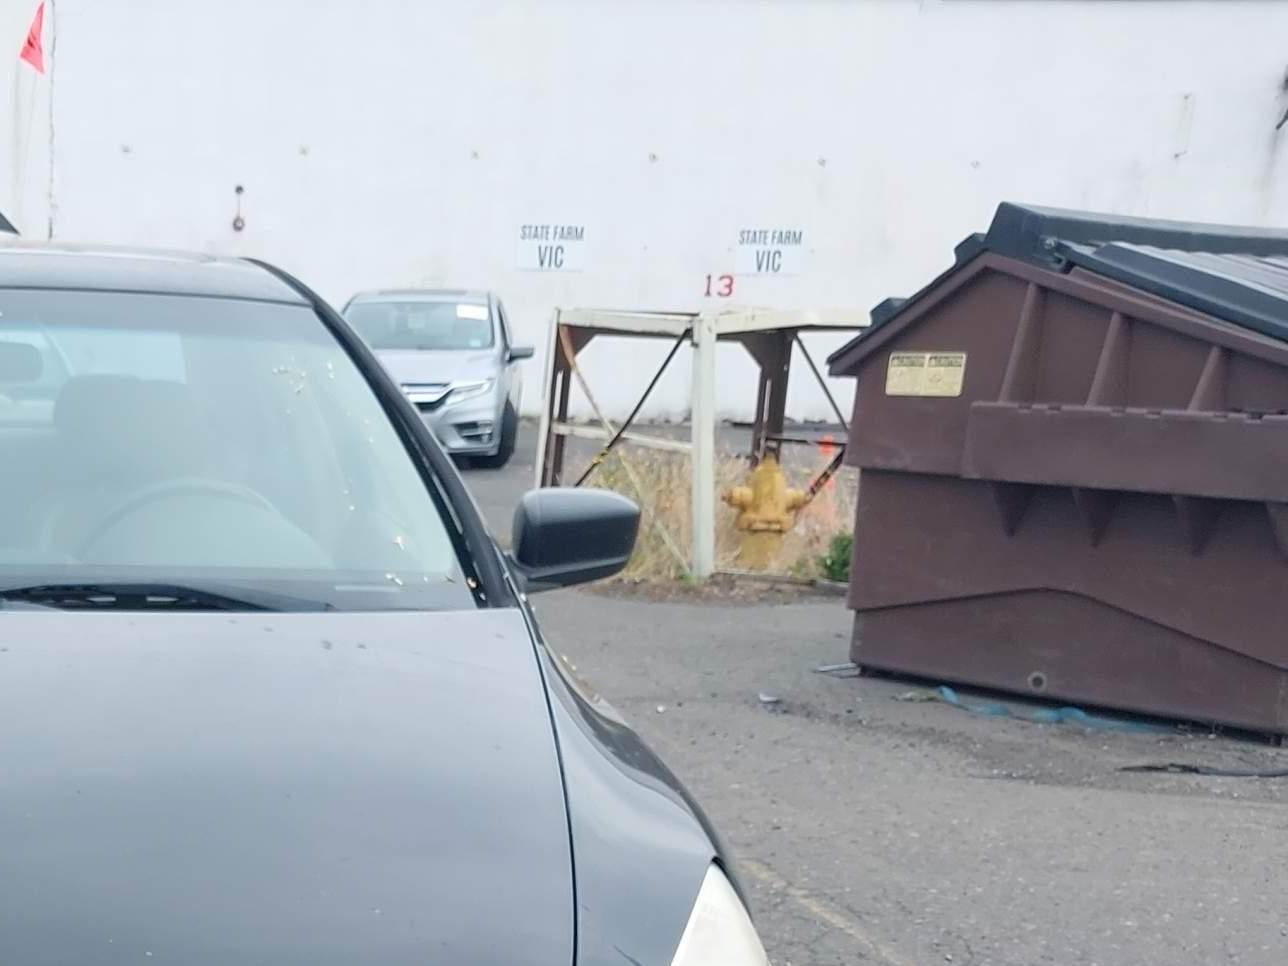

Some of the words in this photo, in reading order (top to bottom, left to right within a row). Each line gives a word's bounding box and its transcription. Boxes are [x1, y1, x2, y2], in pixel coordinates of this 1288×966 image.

[520, 224, 550, 241] STATE
[552, 225, 585, 242] FARM
[739, 229, 768, 245] STATE
[771, 230, 803, 245] FARM
[538, 245, 564, 269] VIC
[756, 249, 782, 273] VIC
[704, 273, 734, 298] 13
